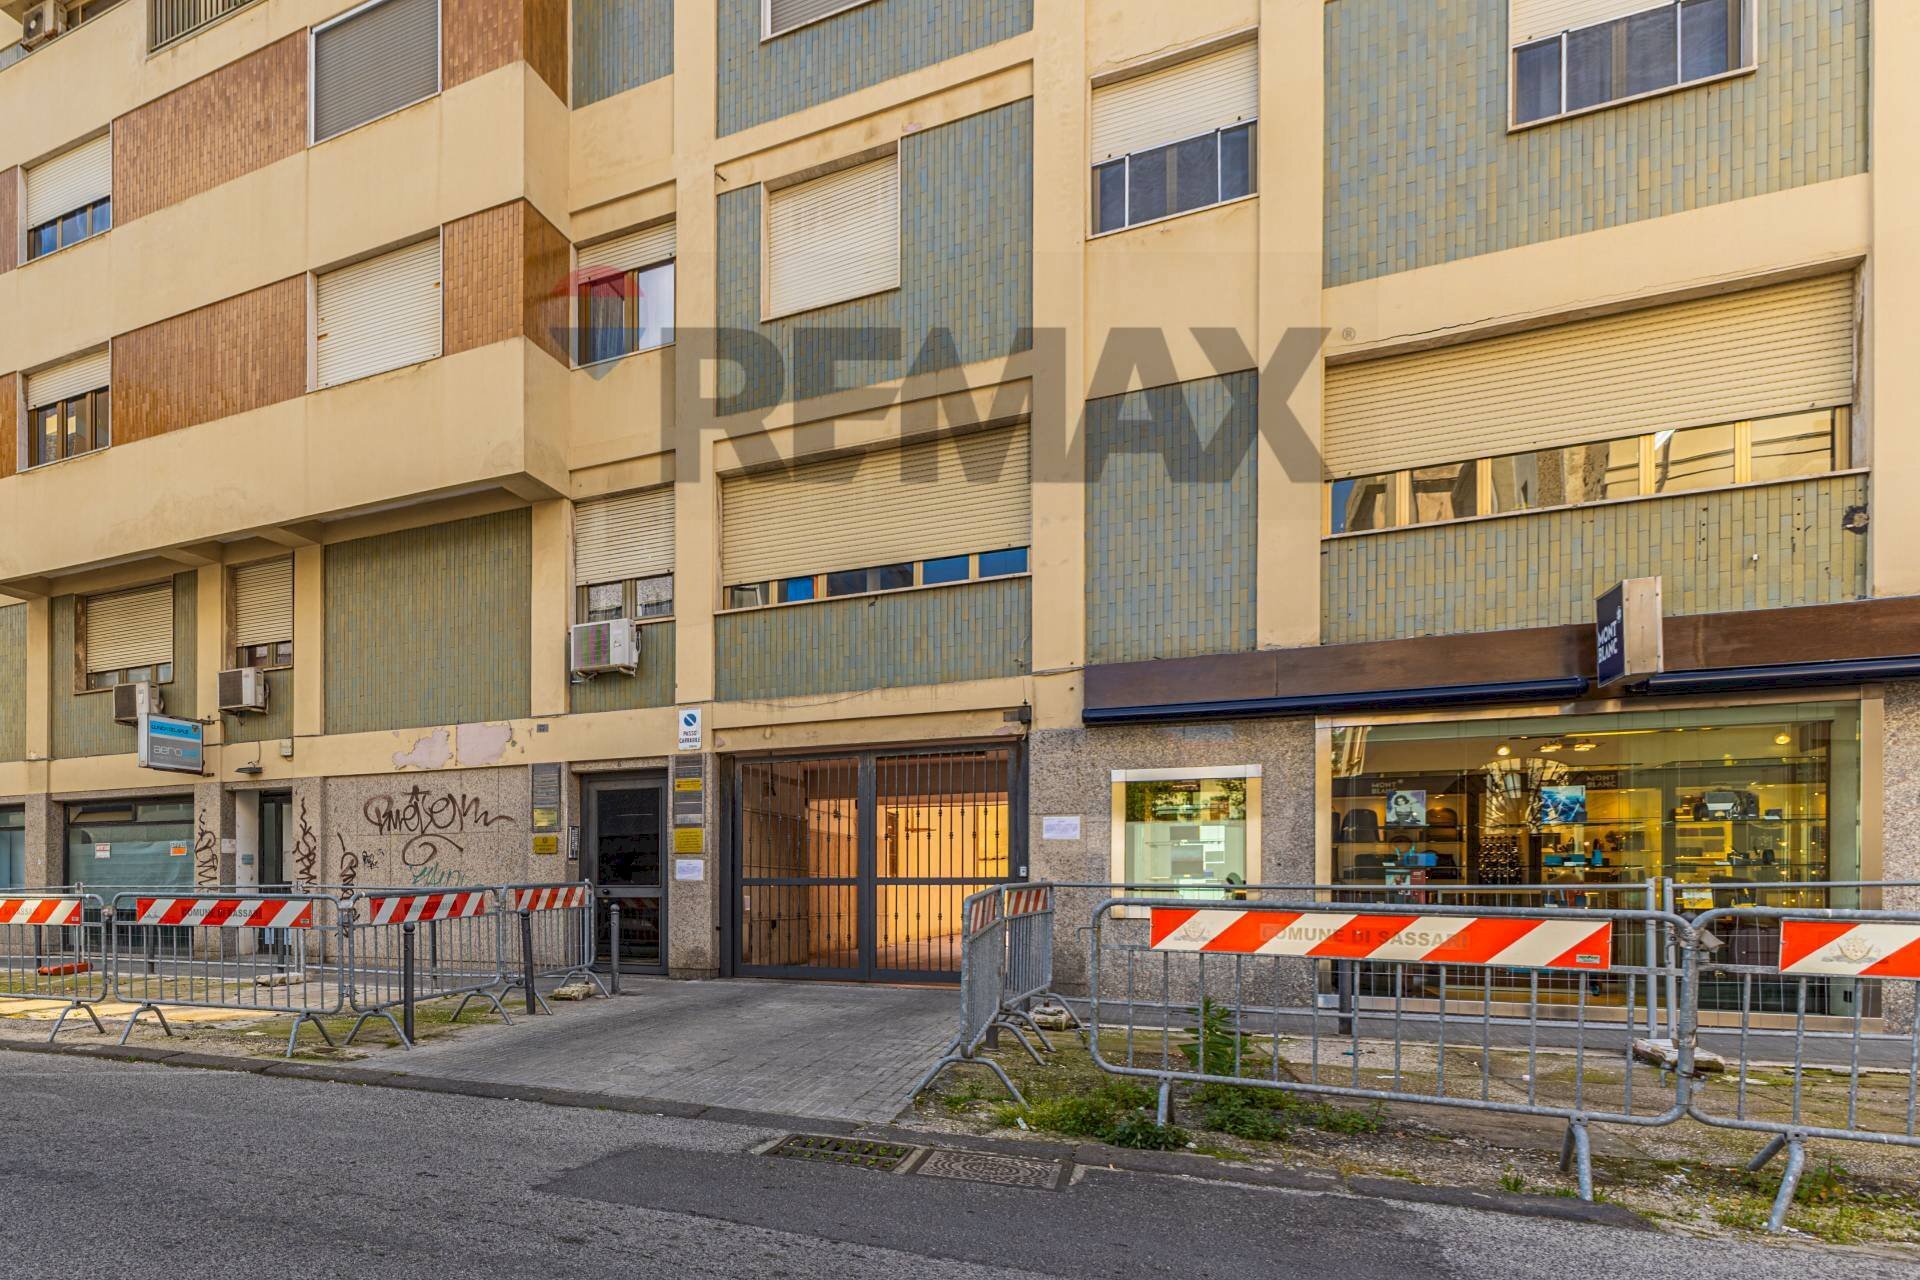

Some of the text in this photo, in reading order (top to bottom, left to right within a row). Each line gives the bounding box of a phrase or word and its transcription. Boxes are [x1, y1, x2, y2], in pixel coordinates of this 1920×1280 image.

[1598, 620, 1616, 648] MONT
[1598, 638, 1618, 664] BLANC
[1261, 925, 1468, 947] COMUNE DI SASSARI
